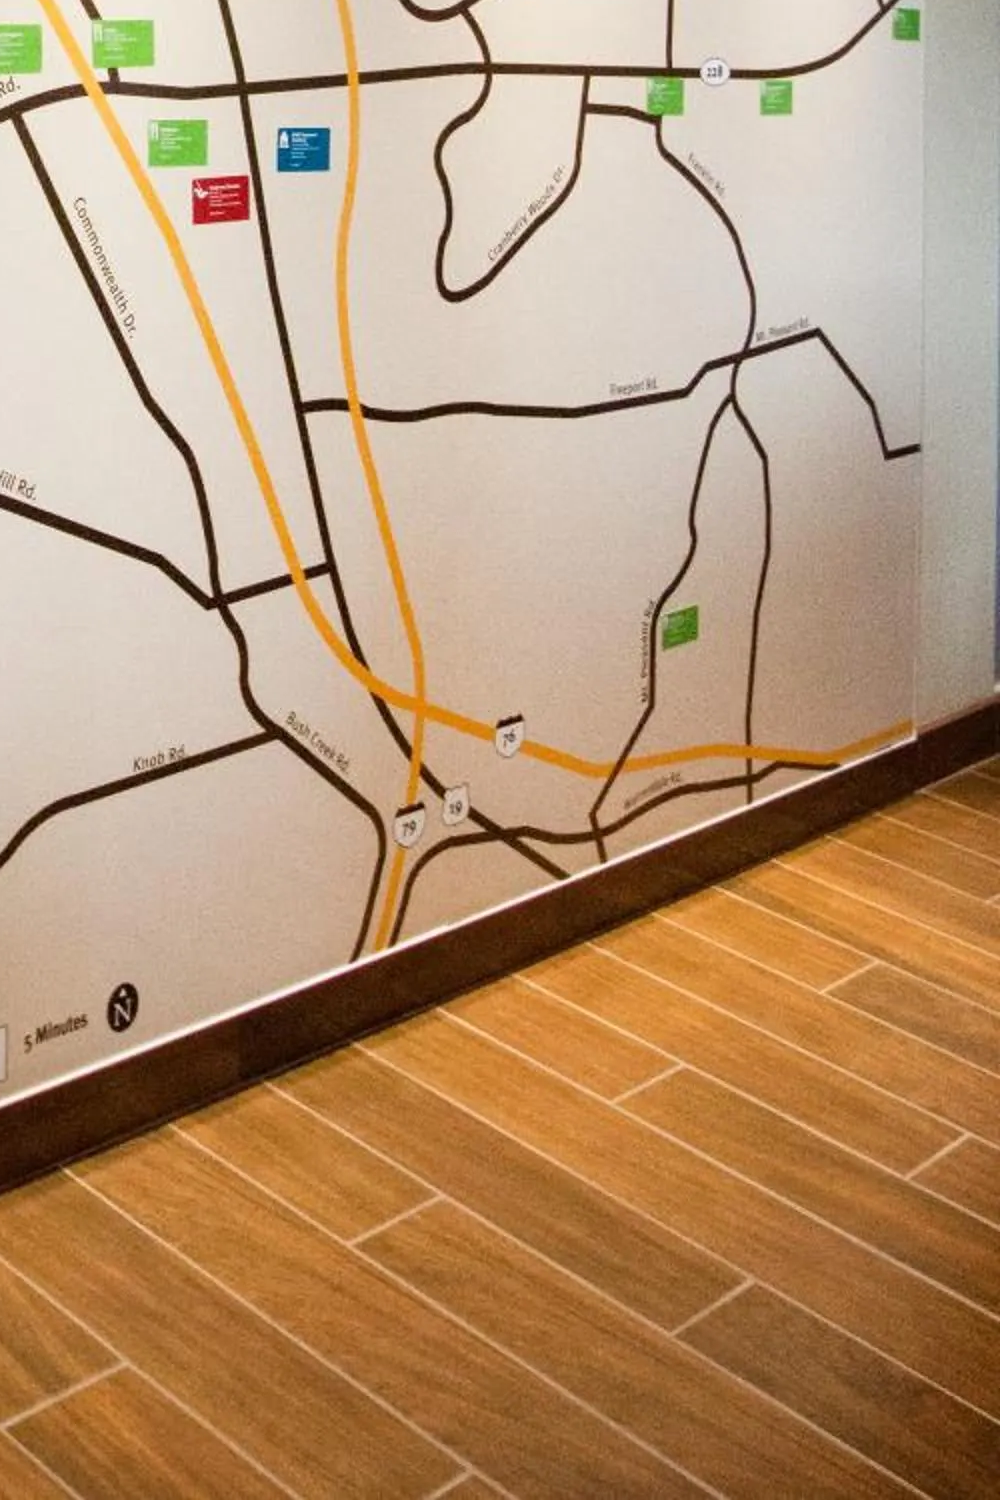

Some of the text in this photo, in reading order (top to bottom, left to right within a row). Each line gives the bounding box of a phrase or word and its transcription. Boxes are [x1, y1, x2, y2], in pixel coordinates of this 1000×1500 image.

[487, 214, 528, 262] Cranberry
[73, 197, 137, 339] Commonwealth Dr.
[17, 478, 37, 501] Rd.
[133, 750, 165, 773] Knob
[311, 730, 336, 762] Creek
[402, 820, 417, 838] 79
[22, 1011, 89, 1054] 5 Minutes
